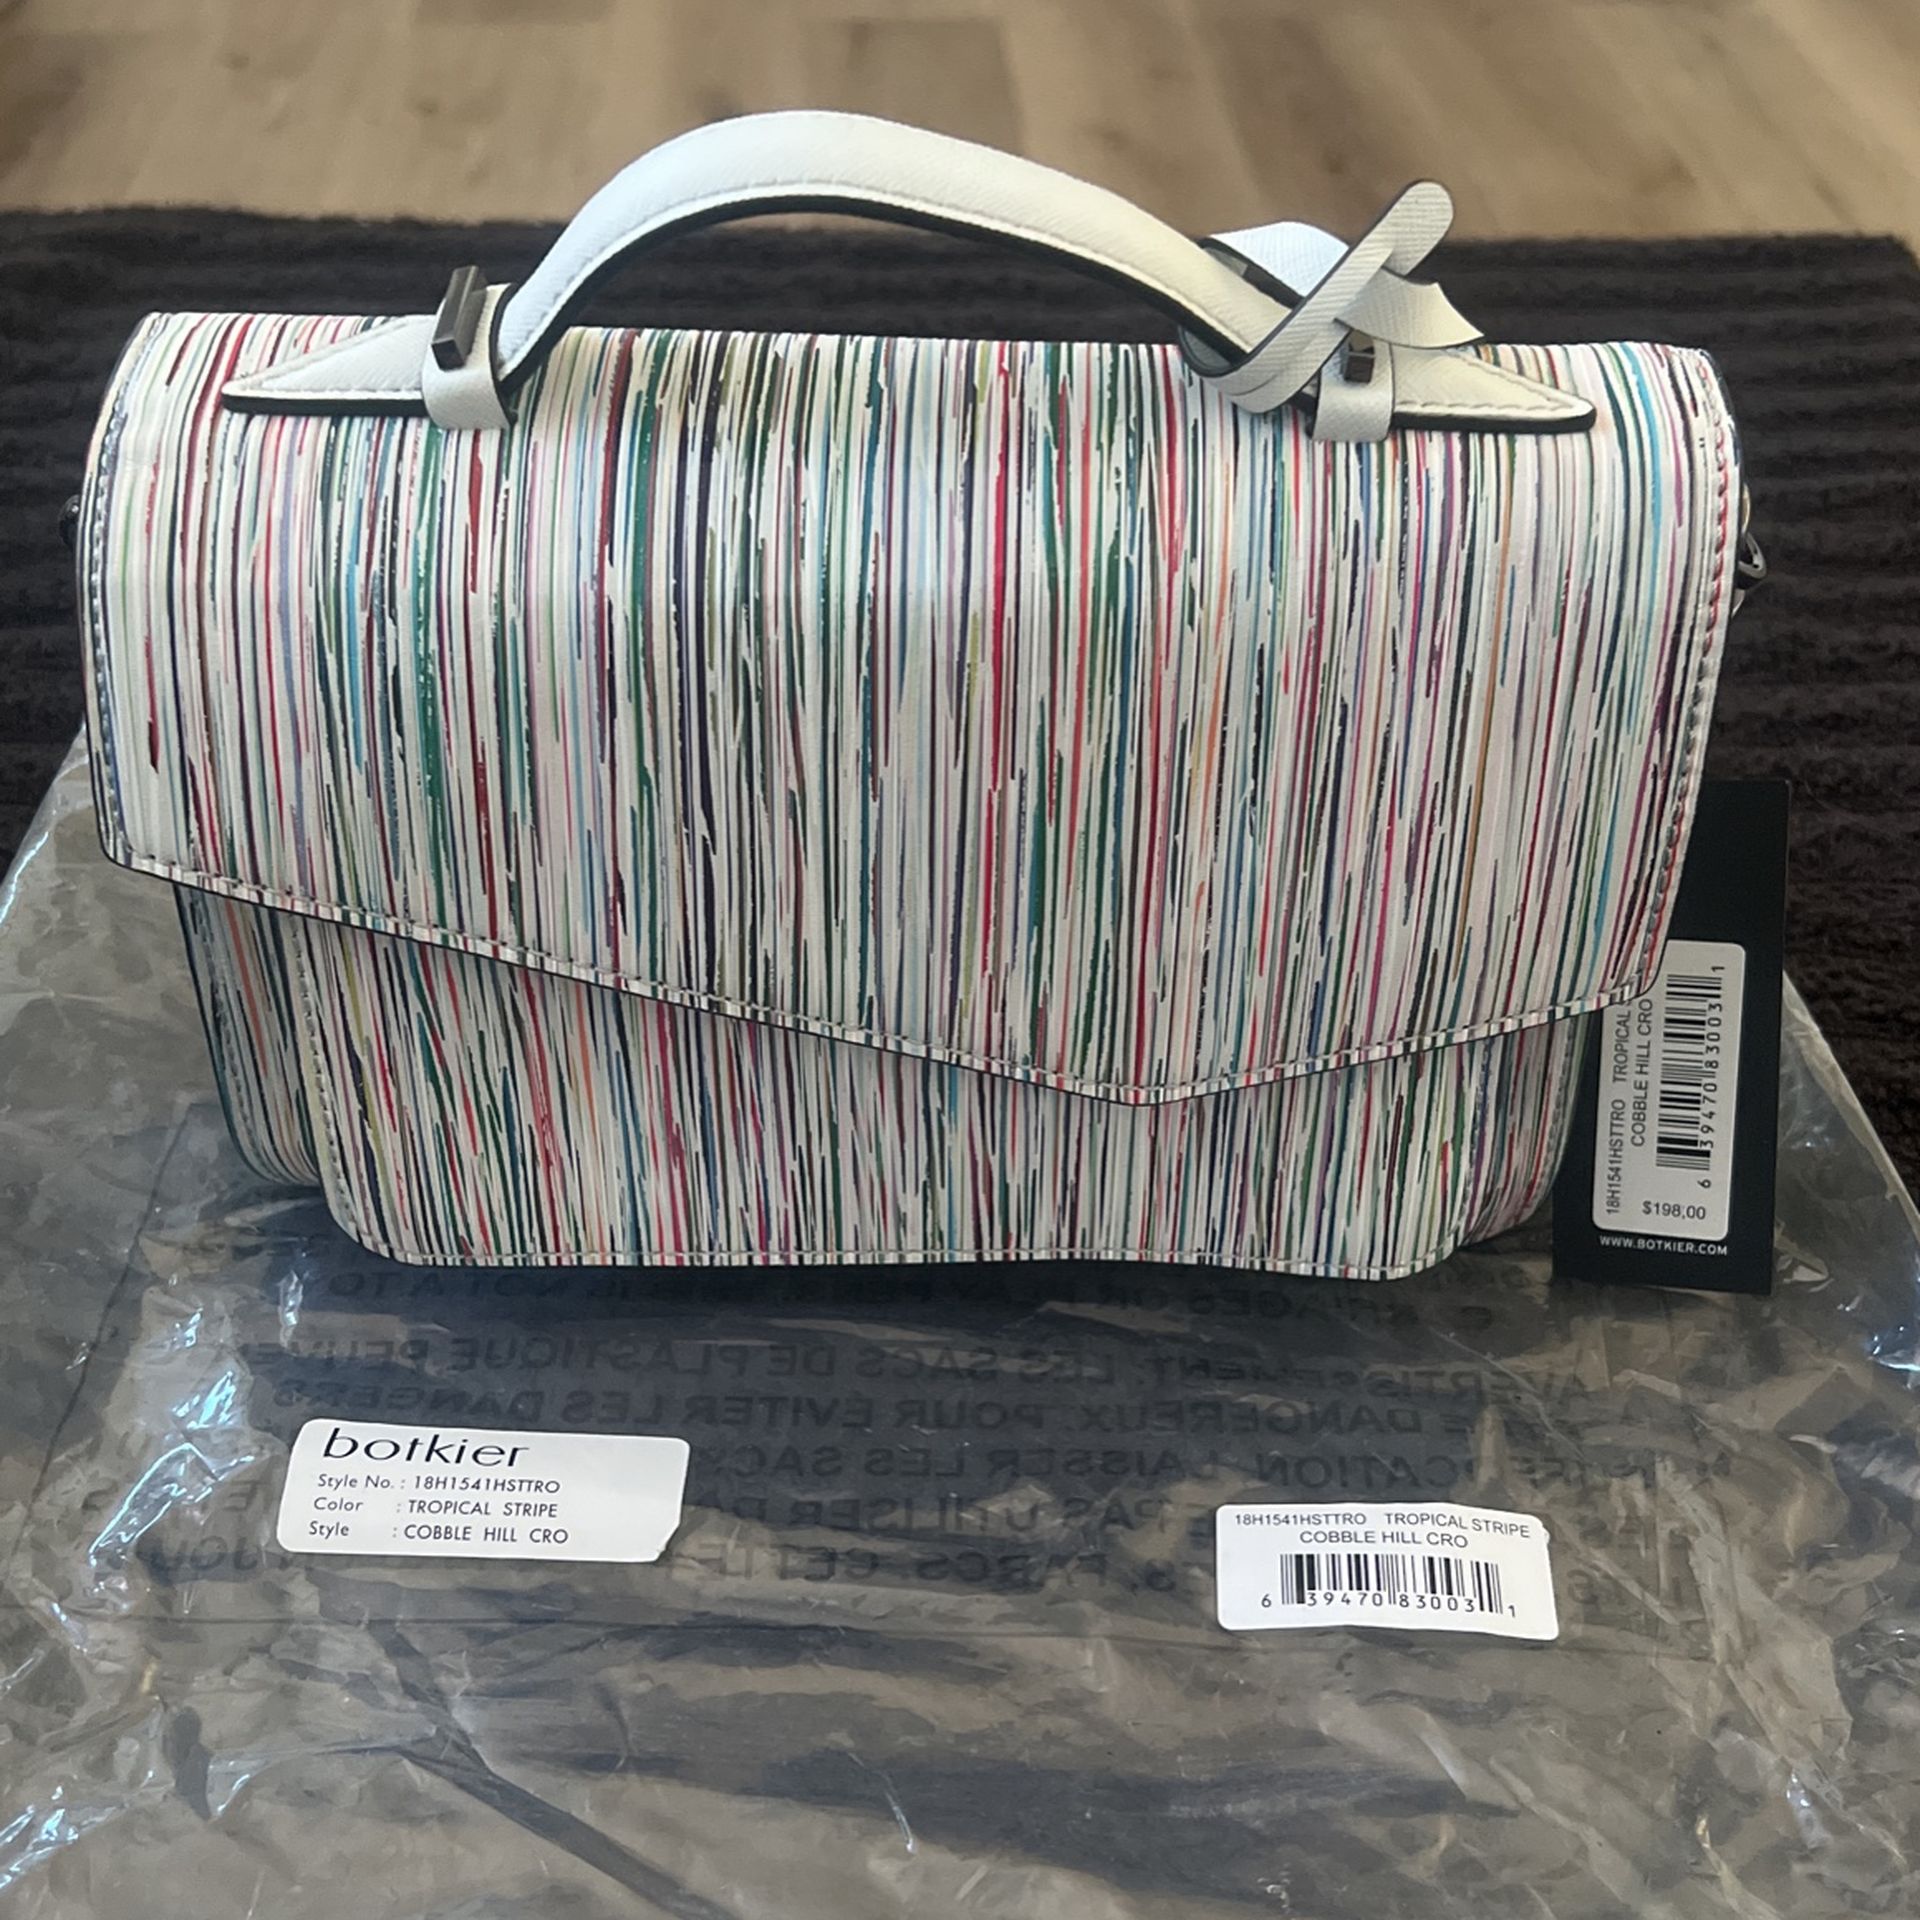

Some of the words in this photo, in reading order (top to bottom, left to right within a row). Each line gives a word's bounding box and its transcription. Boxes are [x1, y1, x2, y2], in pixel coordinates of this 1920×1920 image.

[1637, 998, 1653, 1037] CRO
[1612, 1010, 1631, 1084] TROPICAL
[1635, 1044, 1651, 1077] HILL
[1631, 1080, 1648, 1147] COBBLE
[1606, 1098, 1627, 1214] 18H1541HSTTRO
[1642, 1201, 1706, 1220] $198.00
[1600, 1235, 1728, 1256] WWW.BOTKIER.COM
[323, 1428, 529, 1467] botkier
[318, 1474, 357, 1490] Style
[414, 1475, 560, 1494] 18H1541HSTTRO
[313, 1498, 363, 1512] Color
[408, 1500, 491, 1516] TROPICAL
[503, 1503, 558, 1518] STRIPE
[309, 1521, 349, 1537] Style
[404, 1524, 472, 1541] COBBLE
[484, 1526, 517, 1542] HILL
[530, 1528, 568, 1544] CRO
[1235, 1513, 1367, 1526] 18H1541HSTTRO
[1384, 1513, 1468, 1530] TROPICAL
[1472, 1518, 1531, 1538] STRIPE
[1300, 1530, 1376, 1544] COBBLE
[1382, 1531, 1422, 1545] HILL
[1426, 1531, 1469, 1548] CRO
[1261, 1594, 1272, 1608] 6
[1306, 1592, 1383, 1607] 39470
[1398, 1592, 1475, 1613] 83003
